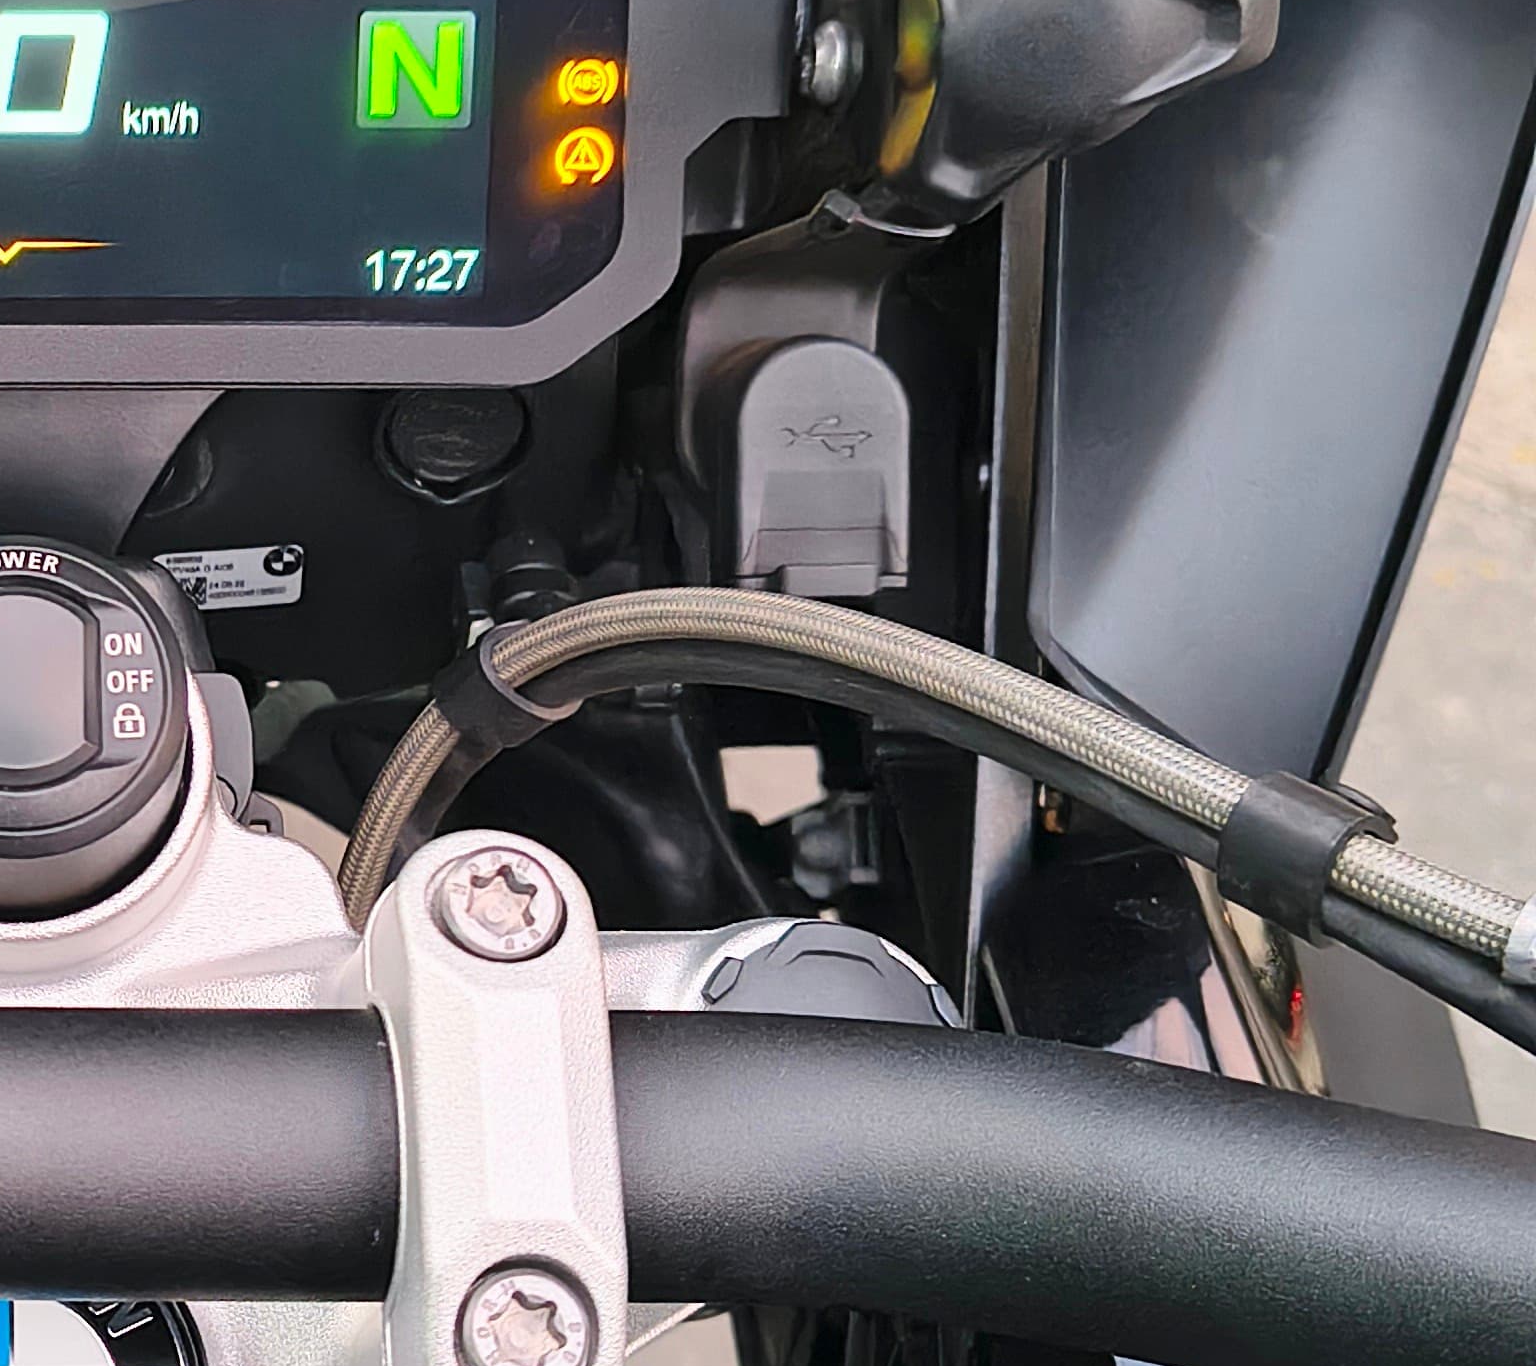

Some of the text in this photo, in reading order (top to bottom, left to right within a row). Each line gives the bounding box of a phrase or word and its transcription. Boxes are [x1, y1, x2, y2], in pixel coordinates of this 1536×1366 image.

[367, 20, 464, 119] N
[573, 71, 601, 91] ABS
[122, 100, 200, 136] km/h
[365, 249, 480, 292] 17:27
[103, 632, 144, 656] ON
[105, 669, 155, 693] OFF
